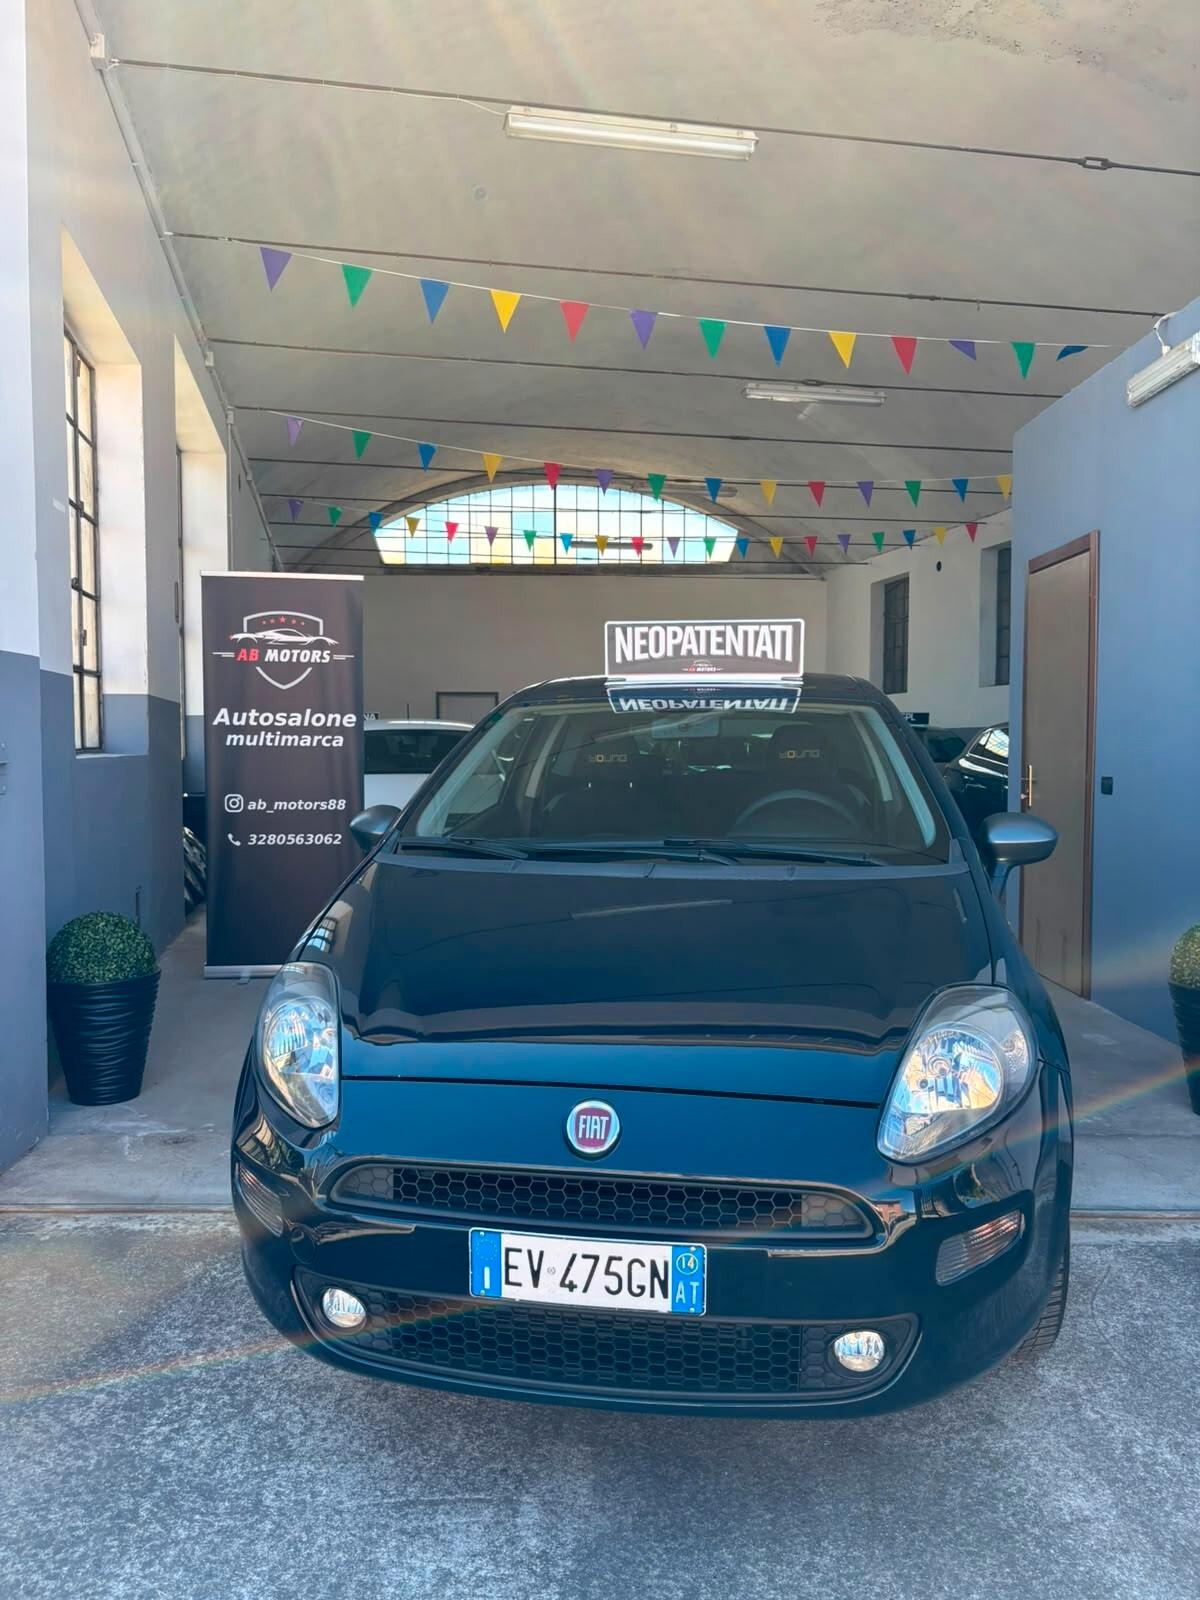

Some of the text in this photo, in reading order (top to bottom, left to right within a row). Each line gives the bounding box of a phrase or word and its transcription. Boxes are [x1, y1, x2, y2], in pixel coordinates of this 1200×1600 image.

[615, 624, 793, 663] NEOPATENTATI
[236, 648, 331, 663] AB MOTORS
[212, 707, 357, 727] Autosalone
[225, 731, 344, 747] multimarca
[247, 799, 347, 813] ab_motors88
[247, 833, 342, 846] 3280563062
[577, 1115, 609, 1140] FIAT
[681, 1255, 695, 1270] 14
[504, 1247, 670, 1299] EV 475GN
[675, 1280, 700, 1305] AT
